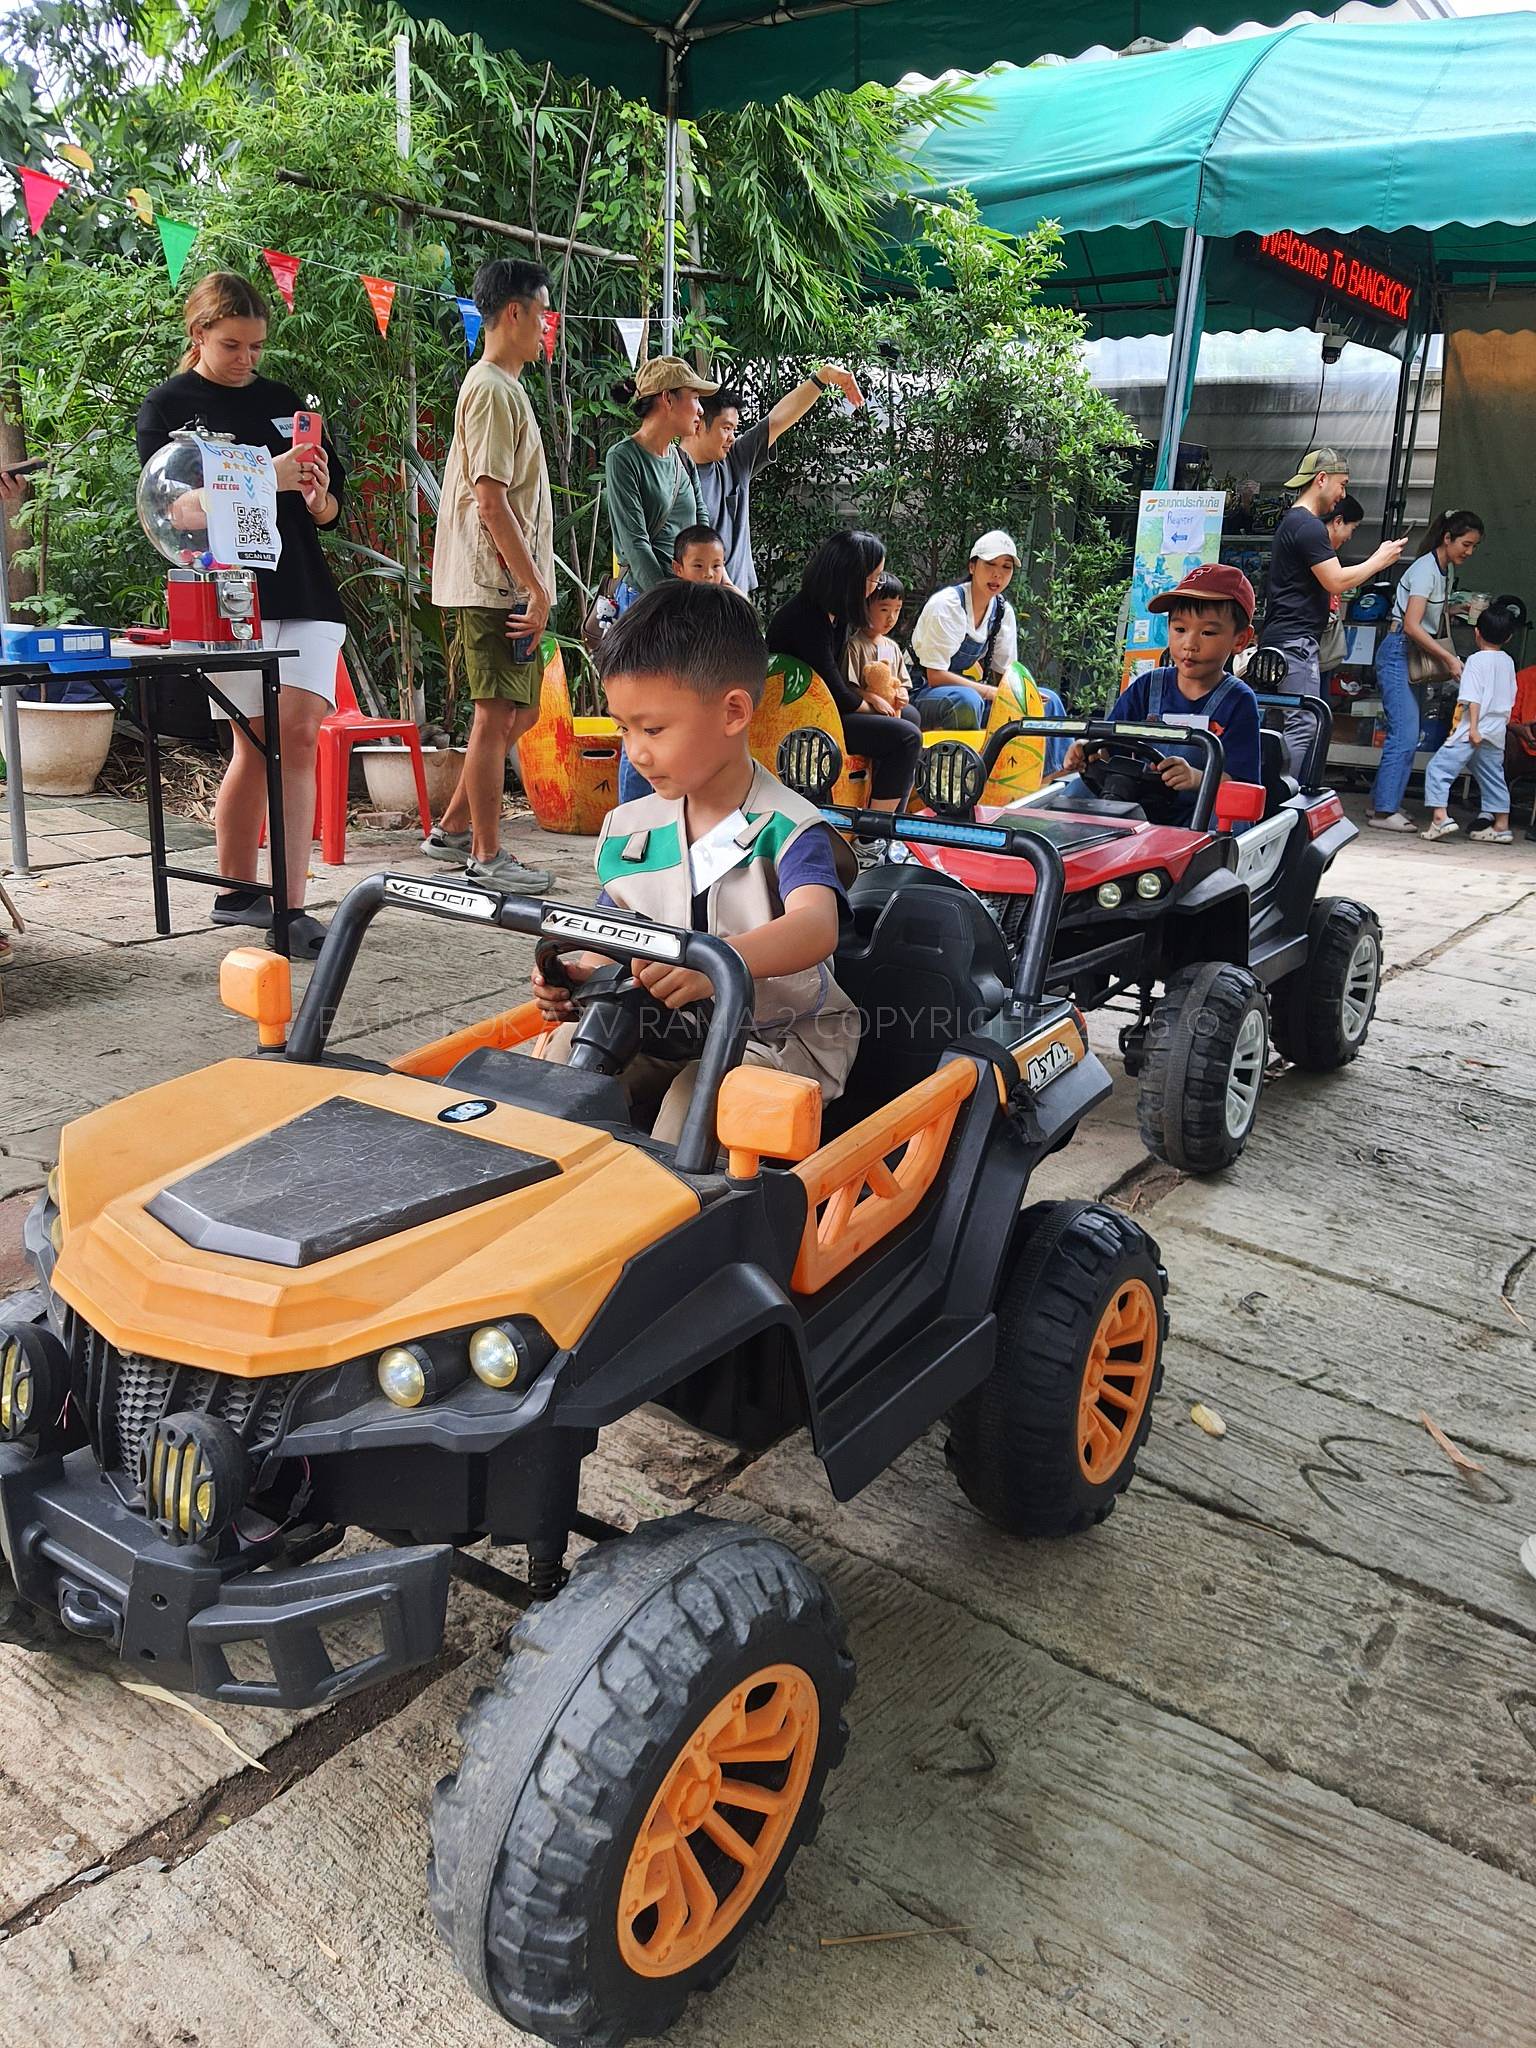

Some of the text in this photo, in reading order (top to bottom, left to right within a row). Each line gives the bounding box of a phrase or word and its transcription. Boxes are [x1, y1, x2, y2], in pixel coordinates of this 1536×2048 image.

[1259, 229, 1329, 280] Welcome
[1331, 250, 1347, 289] To
[212, 482, 227, 490] FREE
[217, 474, 229, 482] GET
[244, 552, 261, 560] SCAN
[389, 882, 478, 908] VELOCIT
[548, 913, 657, 947] VELOCIT
